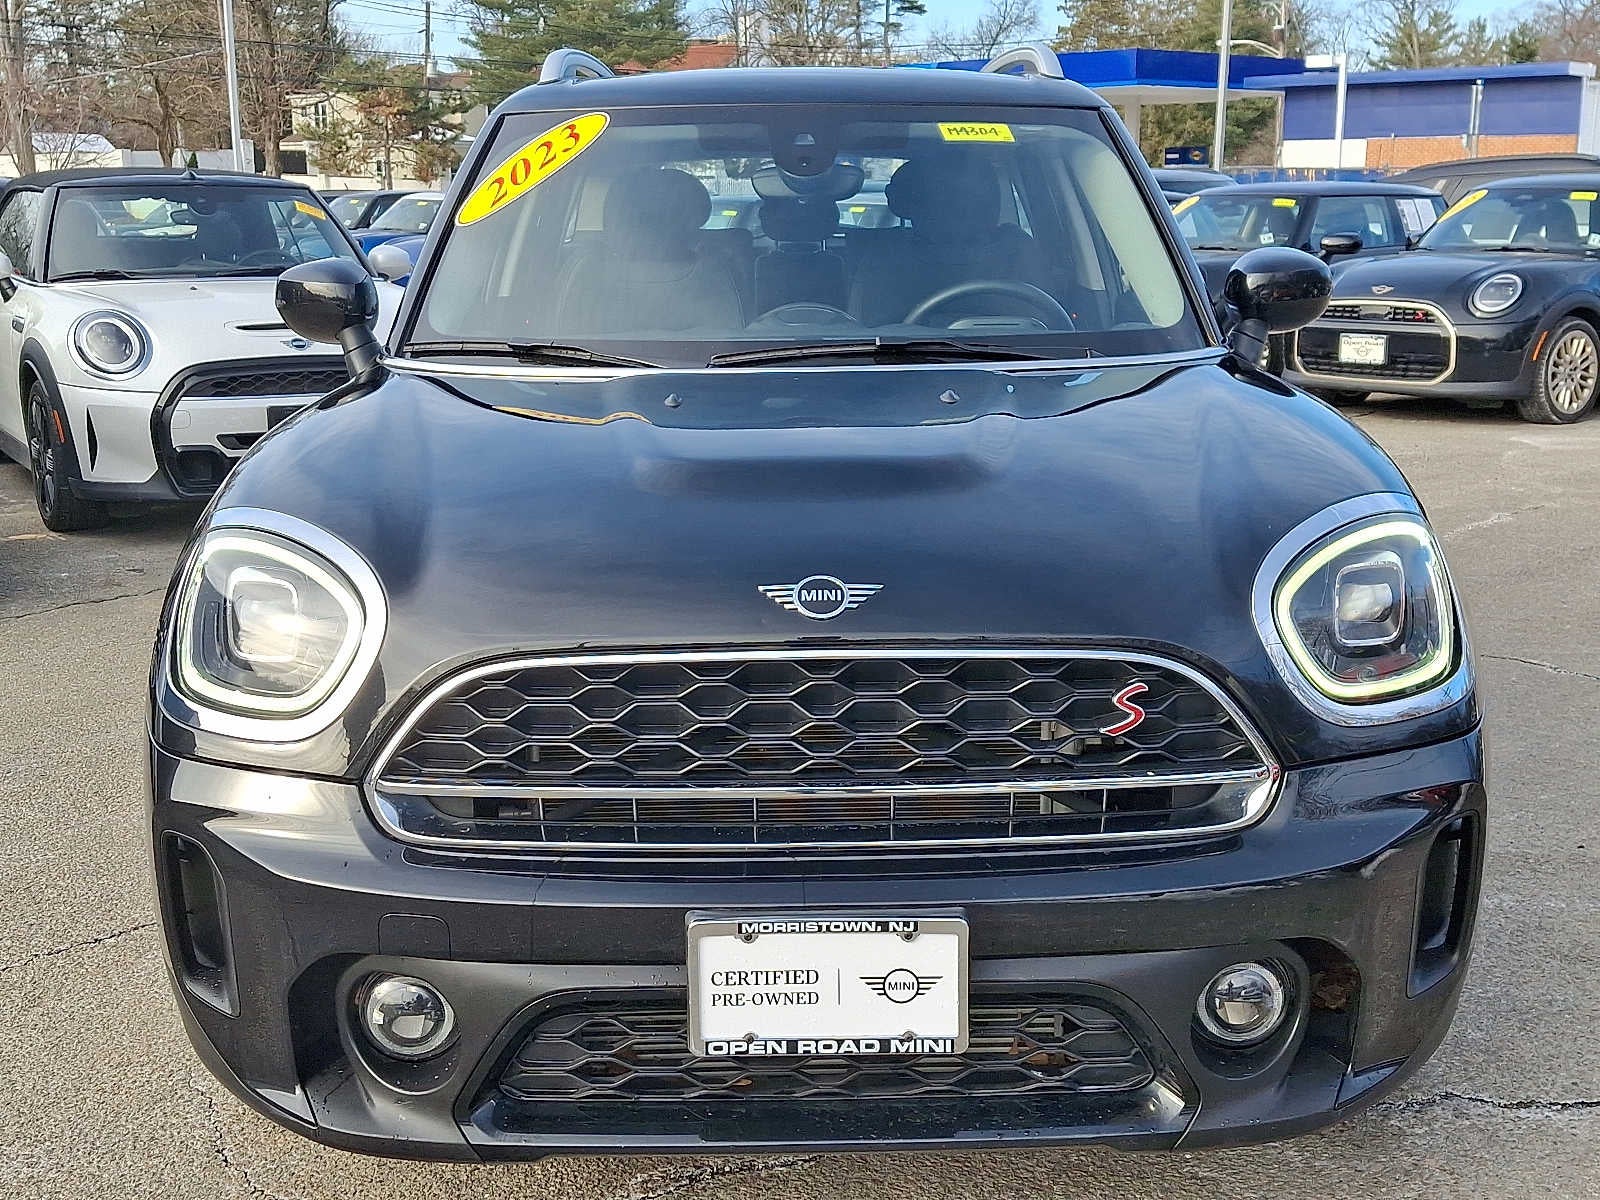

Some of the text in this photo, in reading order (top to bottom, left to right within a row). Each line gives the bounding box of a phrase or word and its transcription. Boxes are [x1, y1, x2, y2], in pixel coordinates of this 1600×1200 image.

[487, 123, 580, 208] 2023
[800, 589, 842, 602] MINI
[1099, 682, 1149, 737] S
[888, 922, 915, 932] NJ
[710, 969, 820, 987] CERTIFIED
[887, 981, 915, 991] MINI
[711, 991, 820, 1007] PRE-OWNED
[707, 1039, 952, 1055] OPEN ROAD MINI
